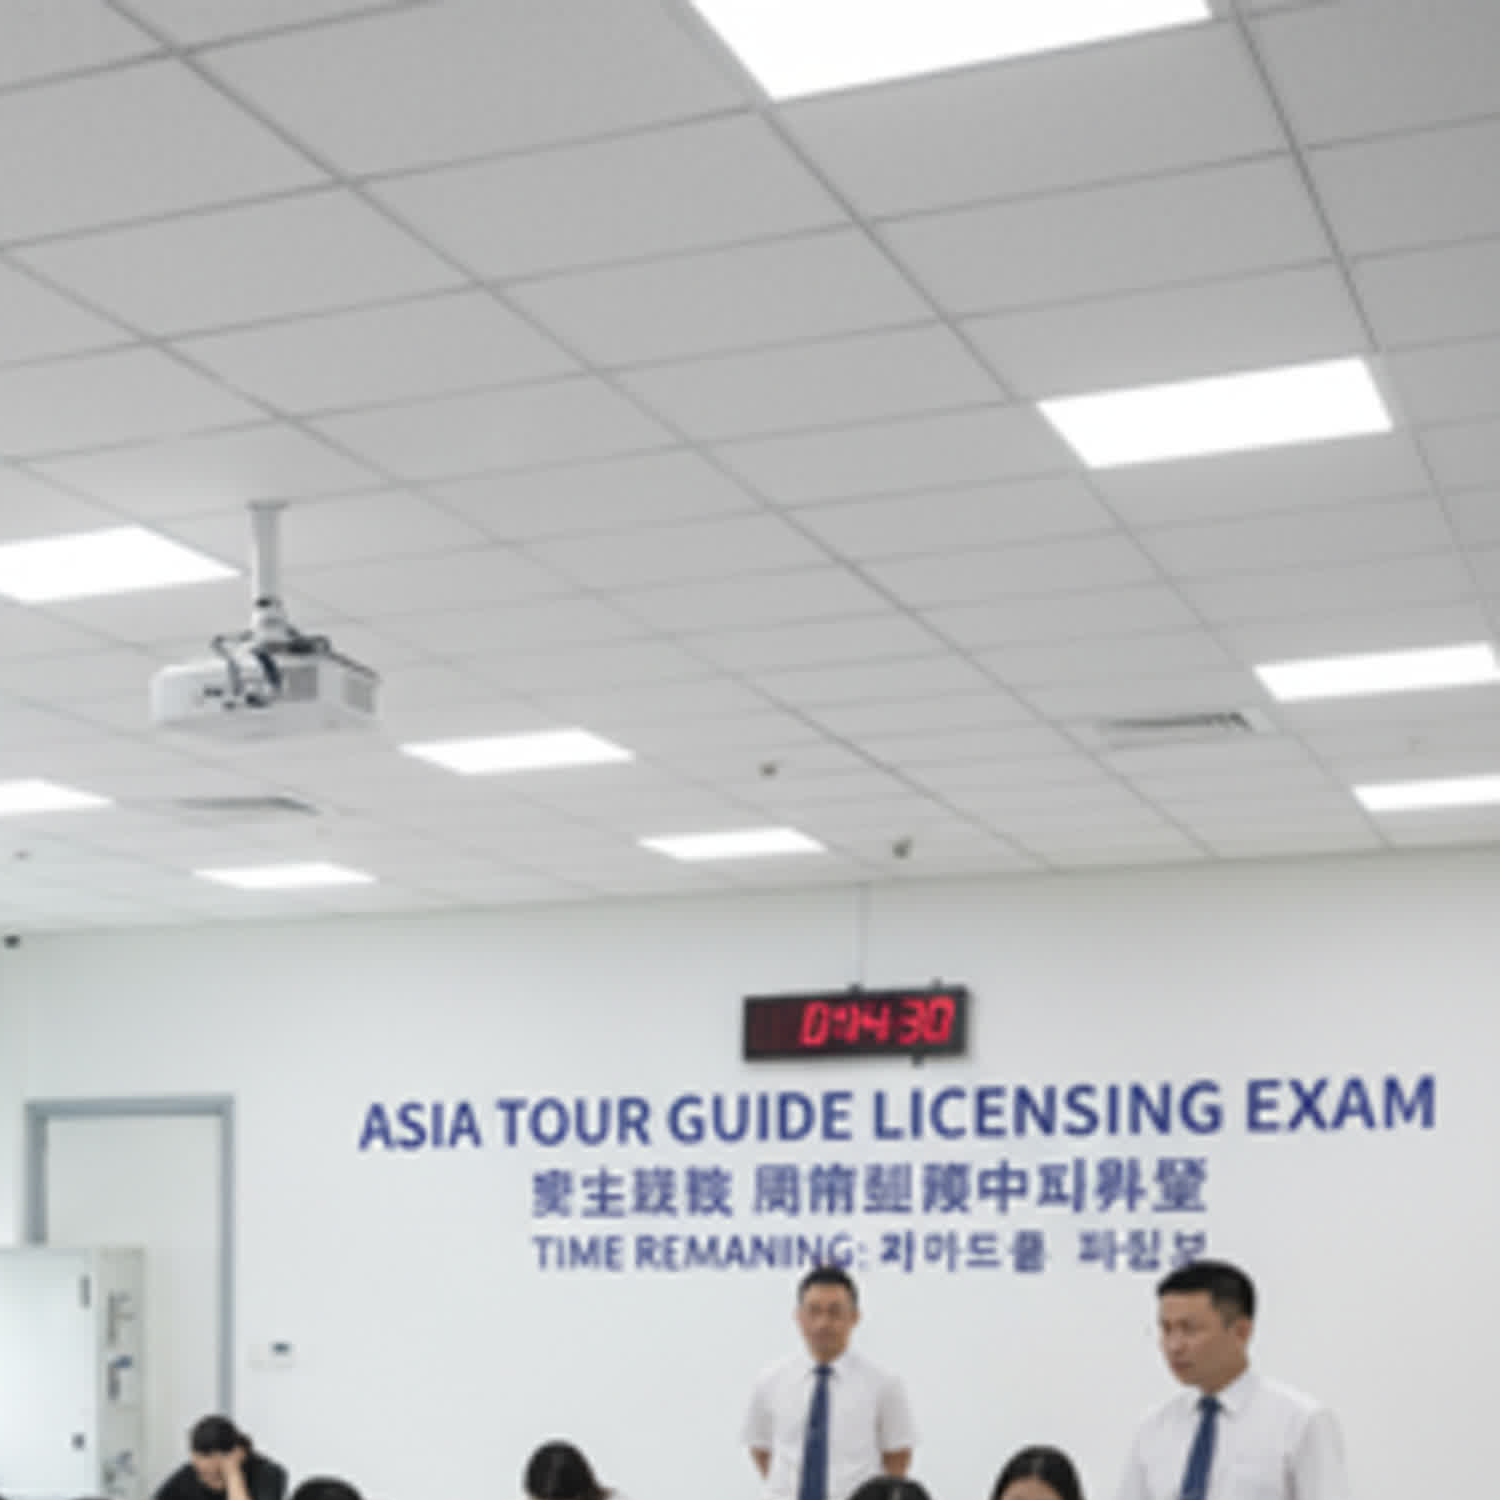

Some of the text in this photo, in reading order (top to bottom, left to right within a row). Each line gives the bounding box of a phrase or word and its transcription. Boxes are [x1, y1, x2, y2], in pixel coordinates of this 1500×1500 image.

[357, 1074, 1437, 1152] ASIA TOUR GUIDE LICENSING EXAM
[532, 1234, 622, 1272] TIME
